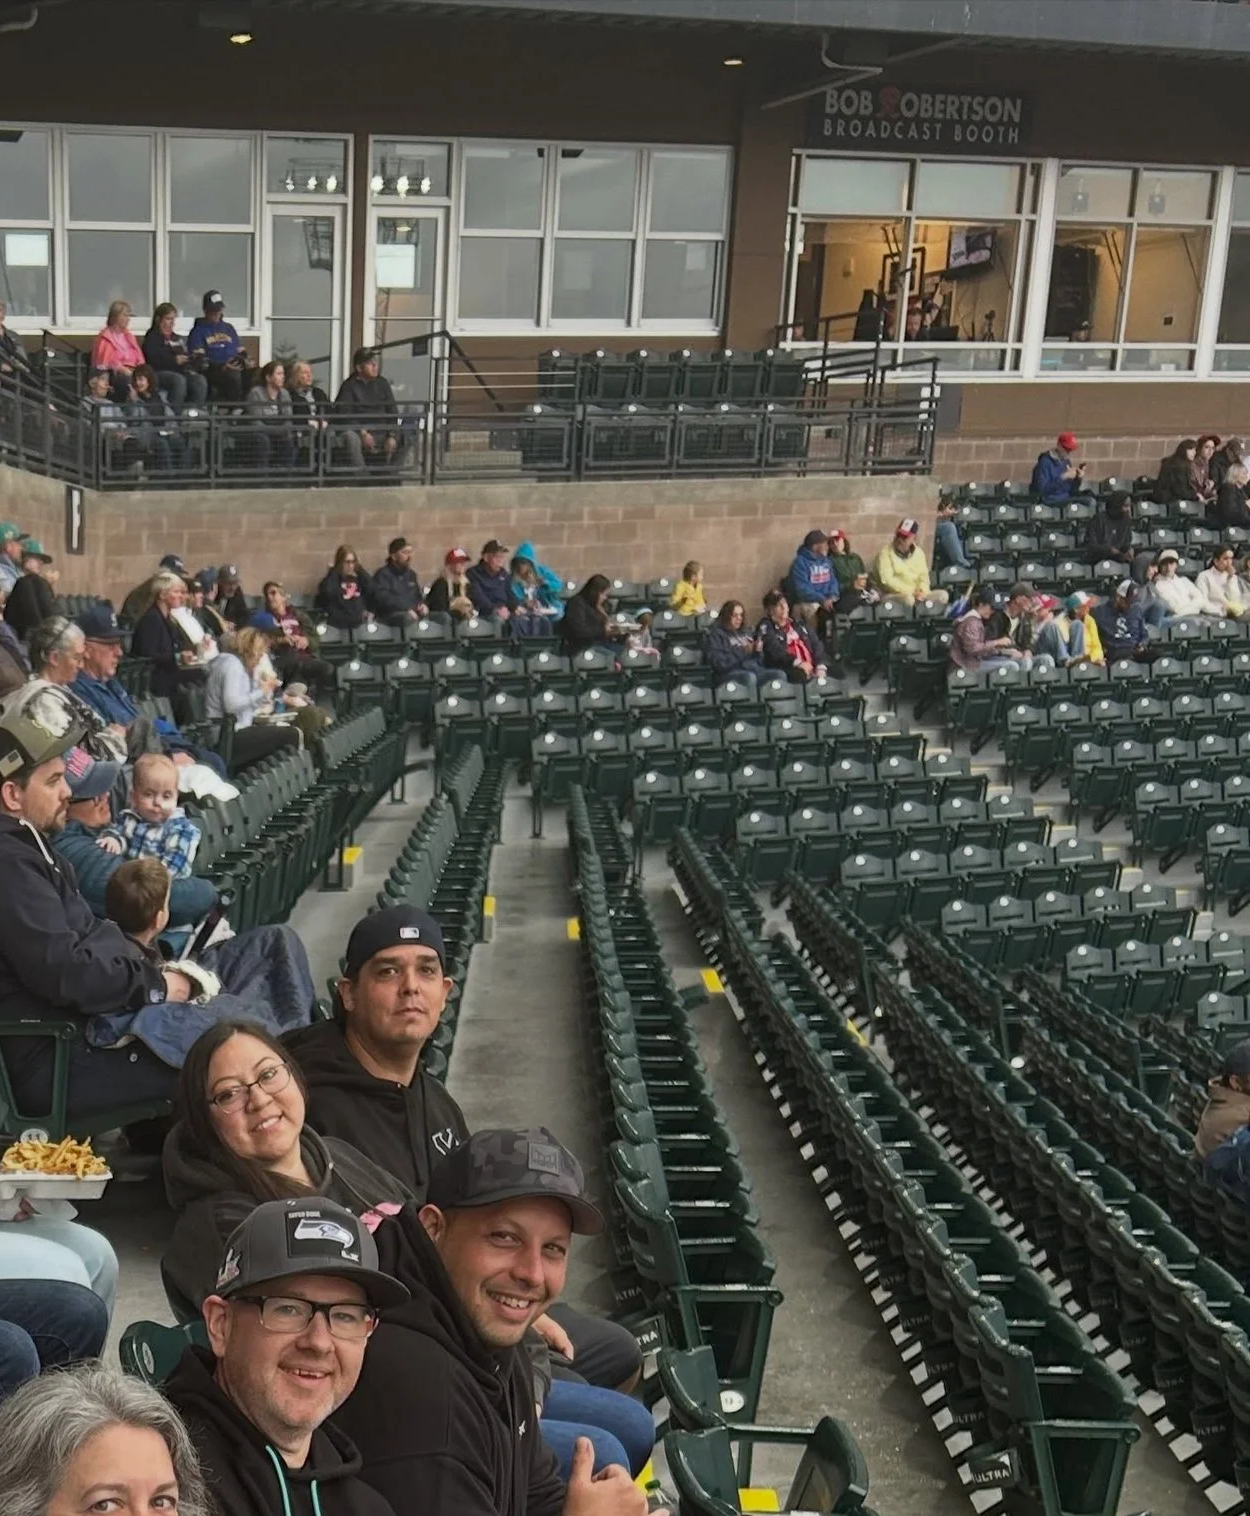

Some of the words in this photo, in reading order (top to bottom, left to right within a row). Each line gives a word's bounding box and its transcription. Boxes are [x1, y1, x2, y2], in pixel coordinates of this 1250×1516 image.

[824, 87, 873, 116] BOB
[824, 118, 942, 141] BROADCAST
[954, 123, 1020, 145] BOOTH
